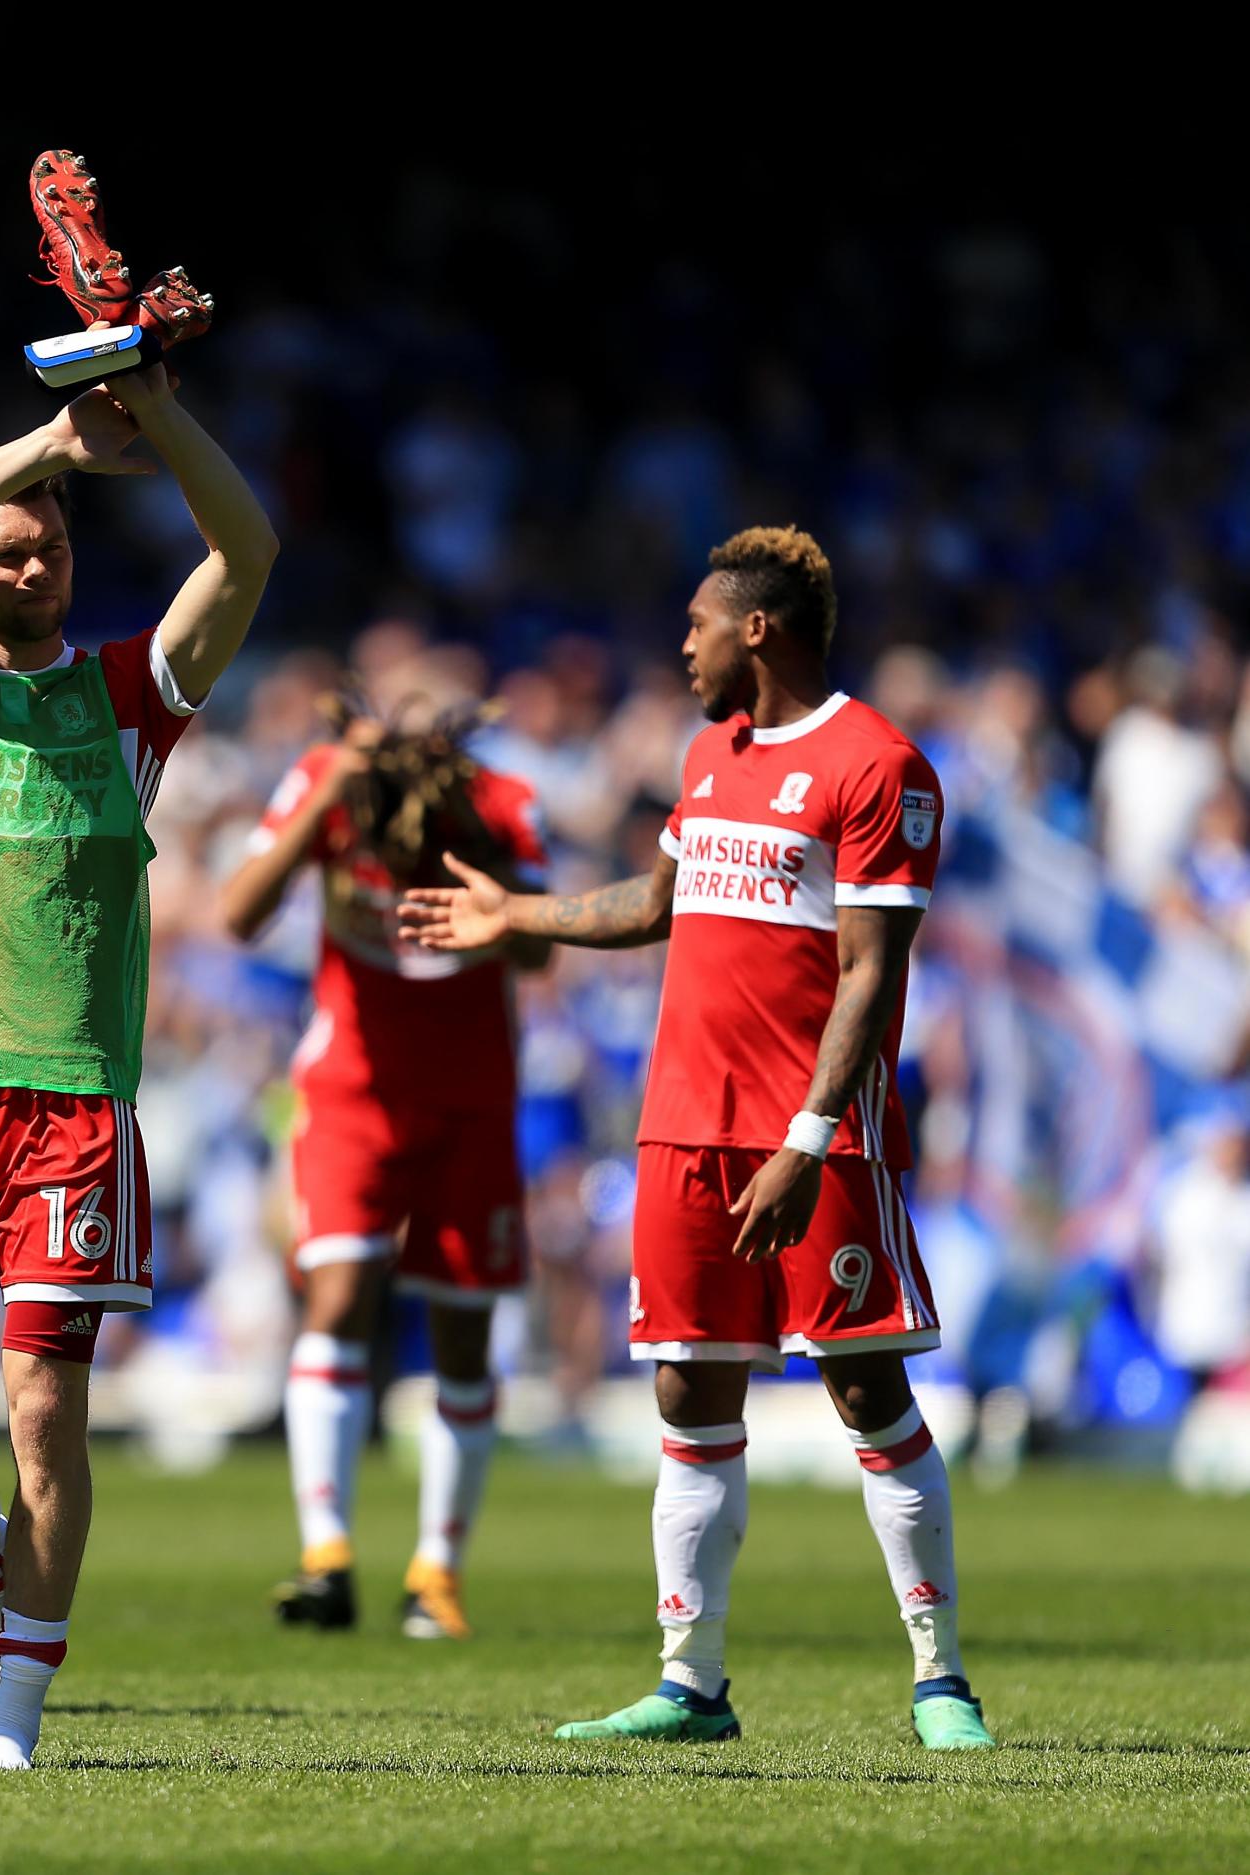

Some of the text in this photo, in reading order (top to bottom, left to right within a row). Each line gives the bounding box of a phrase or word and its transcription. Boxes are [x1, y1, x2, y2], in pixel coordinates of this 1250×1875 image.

[40, 1185, 111, 1259] 16
[830, 1244, 873, 1312] 9
[61, 1325, 95, 1335] adidas
